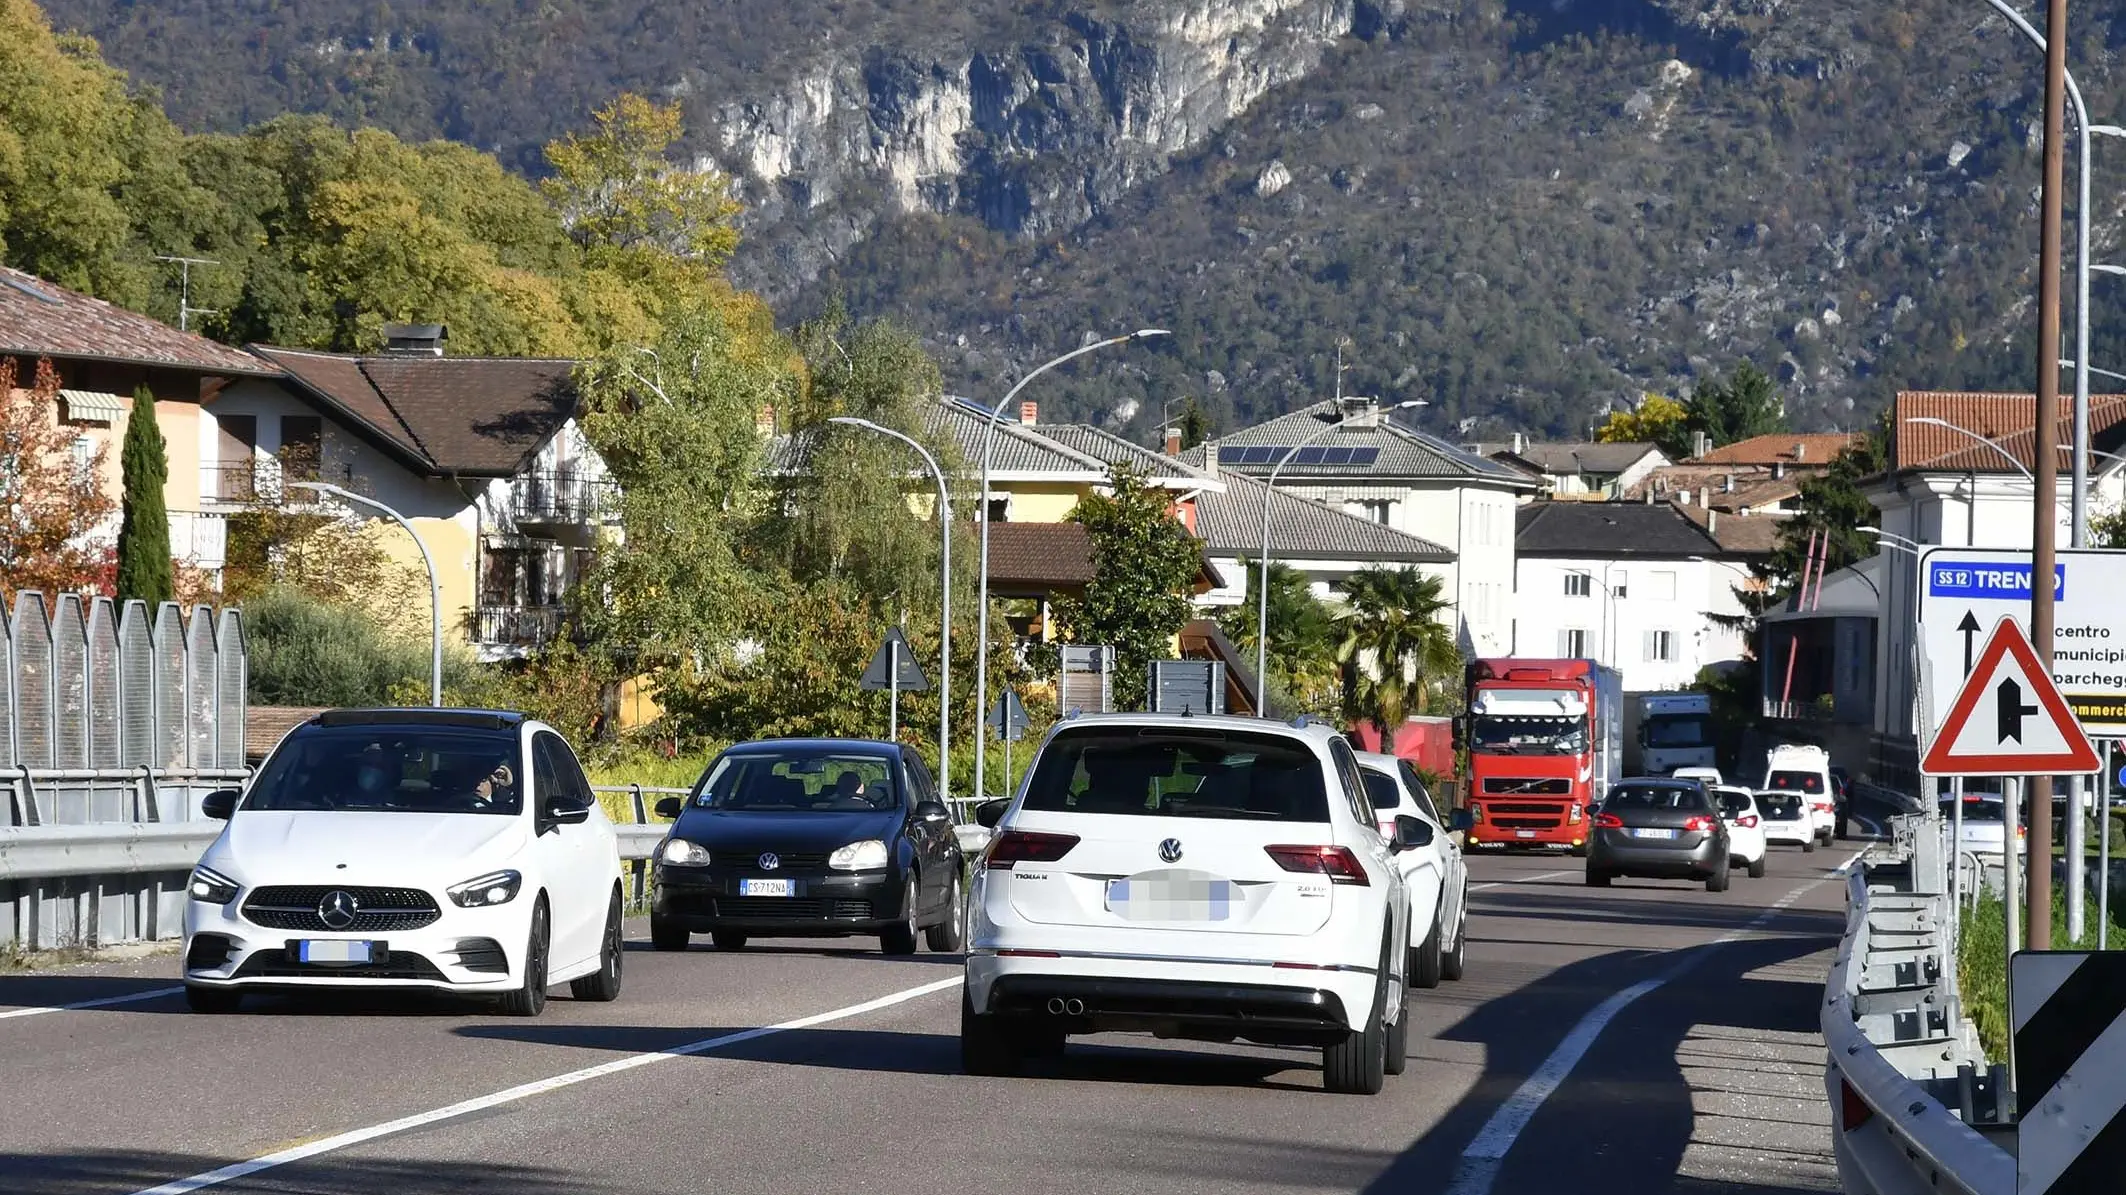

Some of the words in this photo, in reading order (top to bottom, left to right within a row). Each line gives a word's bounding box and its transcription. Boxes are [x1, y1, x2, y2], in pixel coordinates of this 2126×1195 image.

[1939, 571, 1953, 585] SS
[1956, 571, 1967, 585] 12
[1974, 570, 2061, 590] TREN
[2055, 625, 2110, 638] centro
[2054, 648, 2126, 664] municipi
[2053, 671, 2126, 688] parcheg
